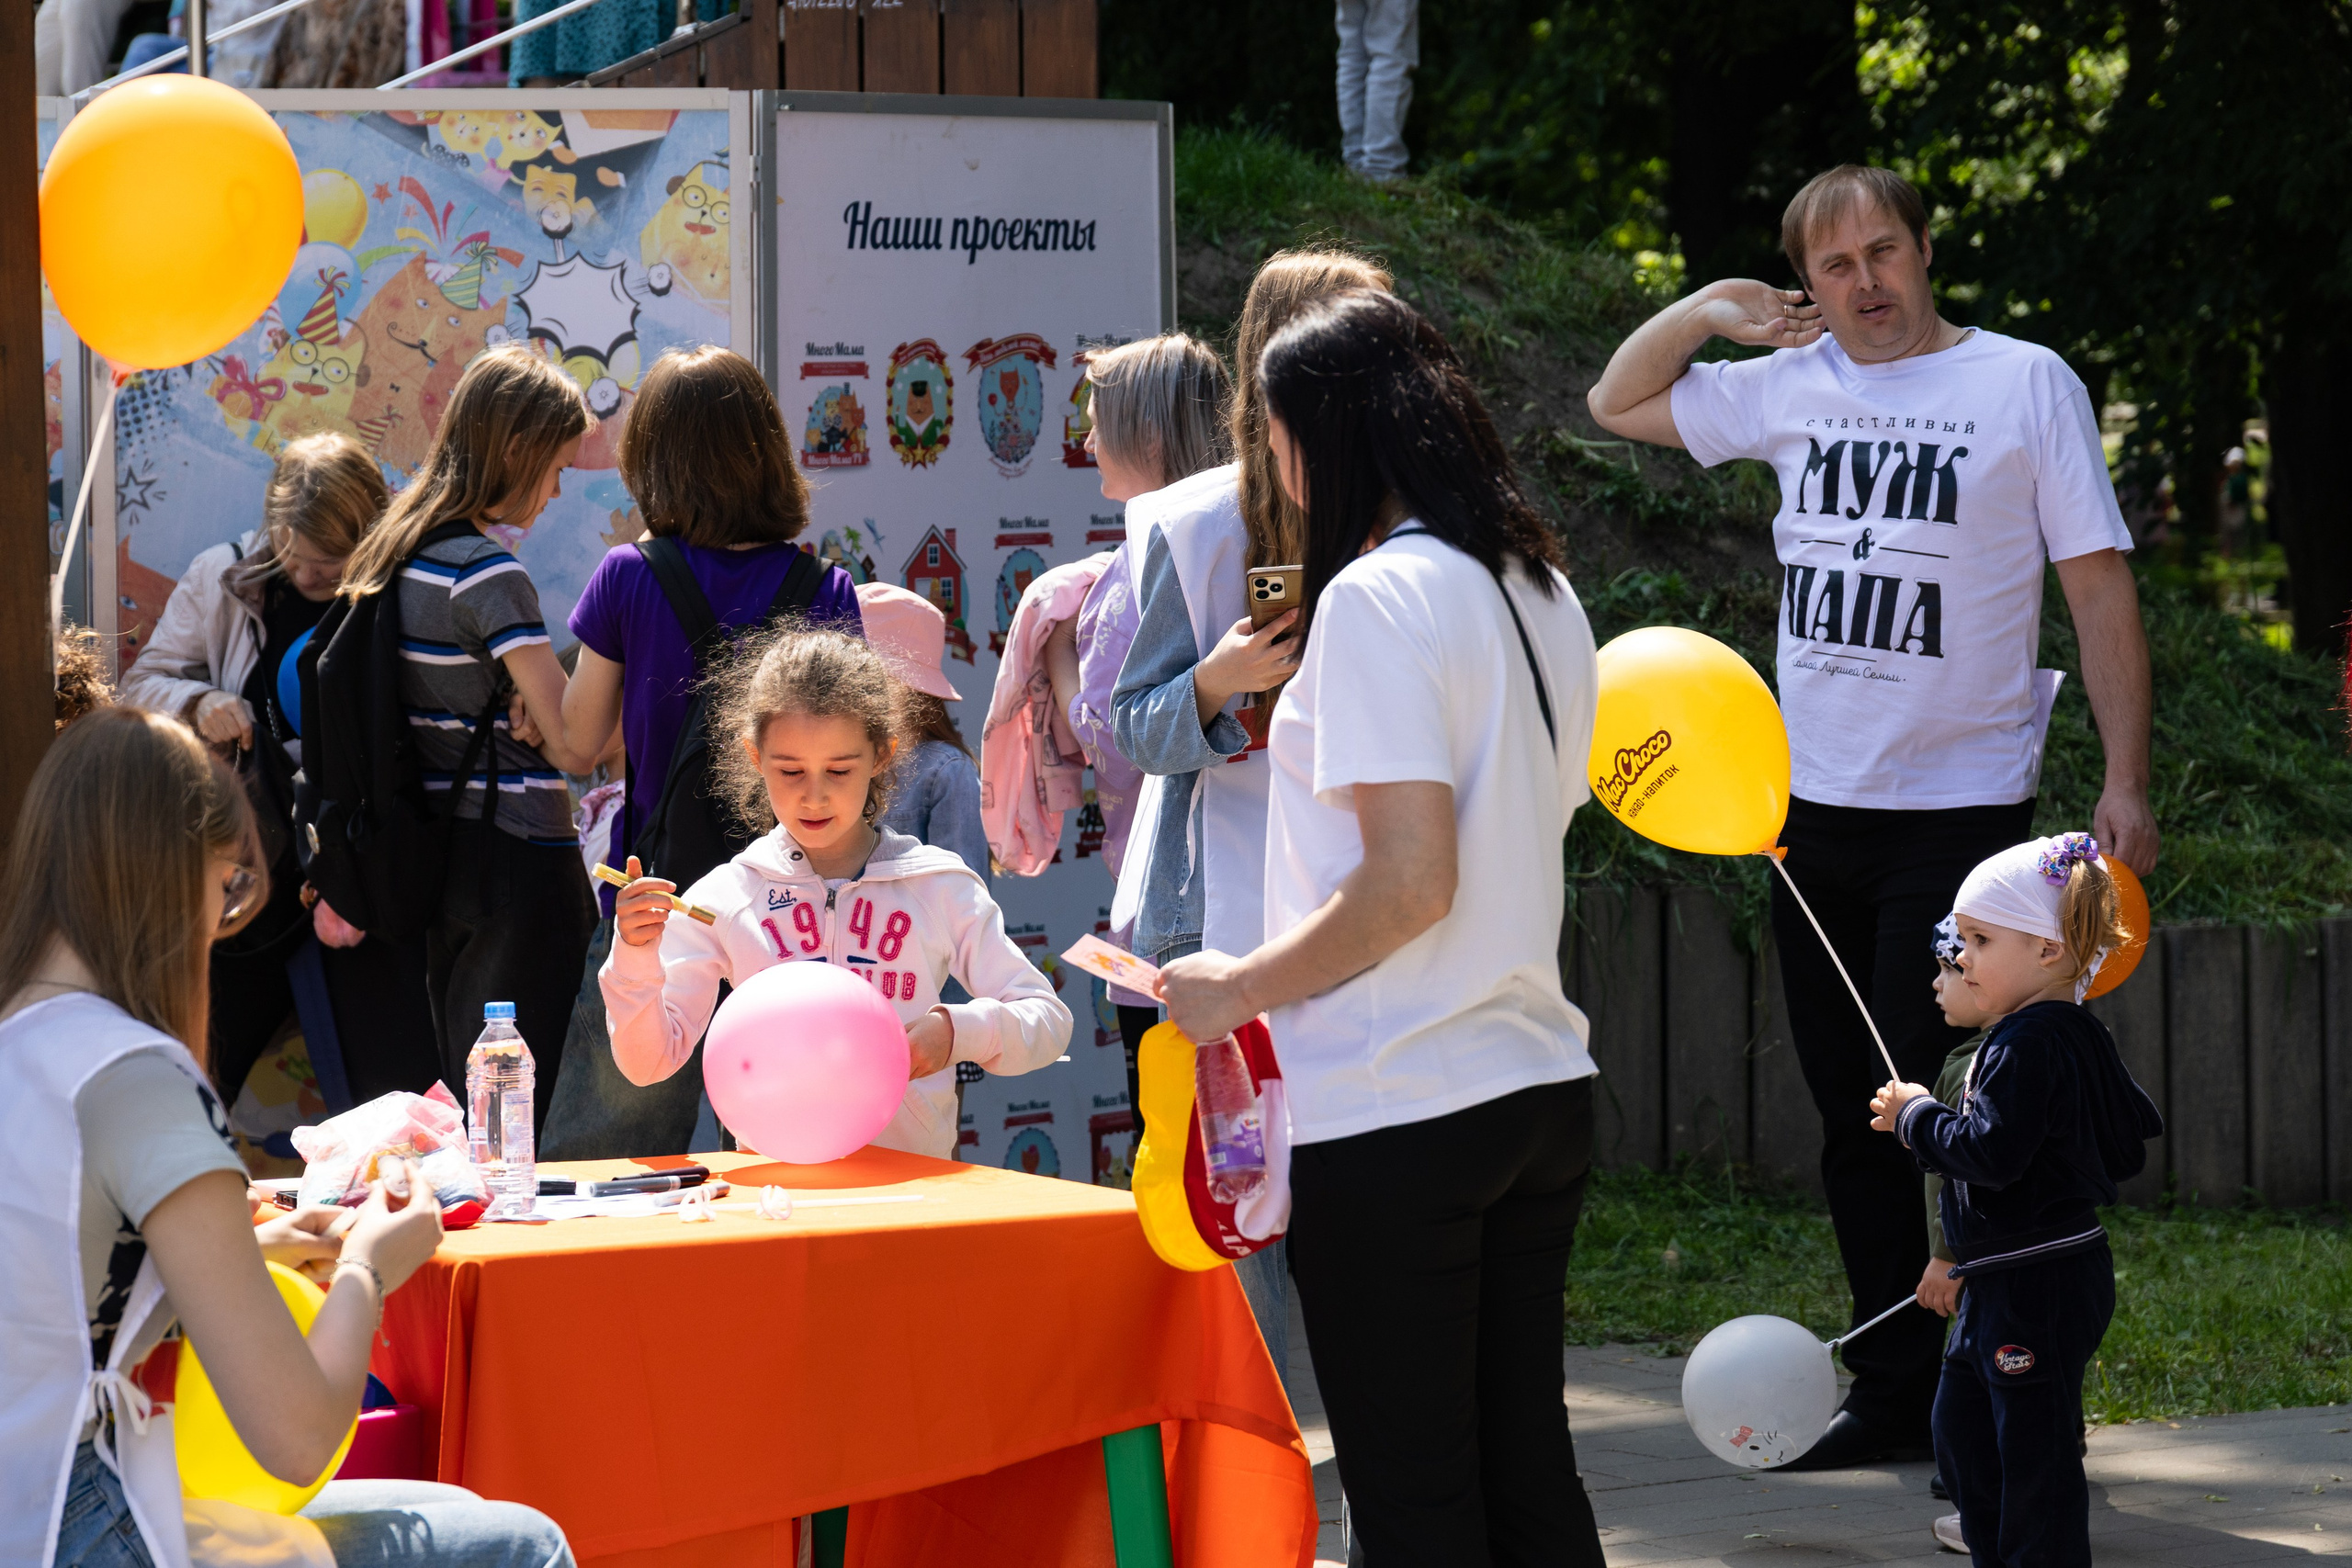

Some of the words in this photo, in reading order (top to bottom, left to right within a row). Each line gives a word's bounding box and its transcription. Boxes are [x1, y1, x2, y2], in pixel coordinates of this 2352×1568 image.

[843, 200, 943, 251] Наши
[949, 215, 1096, 265] проекты
[1794, 434, 1973, 528] МУЖ
[1786, 563, 1945, 659] ПАПА
[1819, 661, 1860, 676] Лучшей
[1597, 729, 1672, 813] MacChoco
